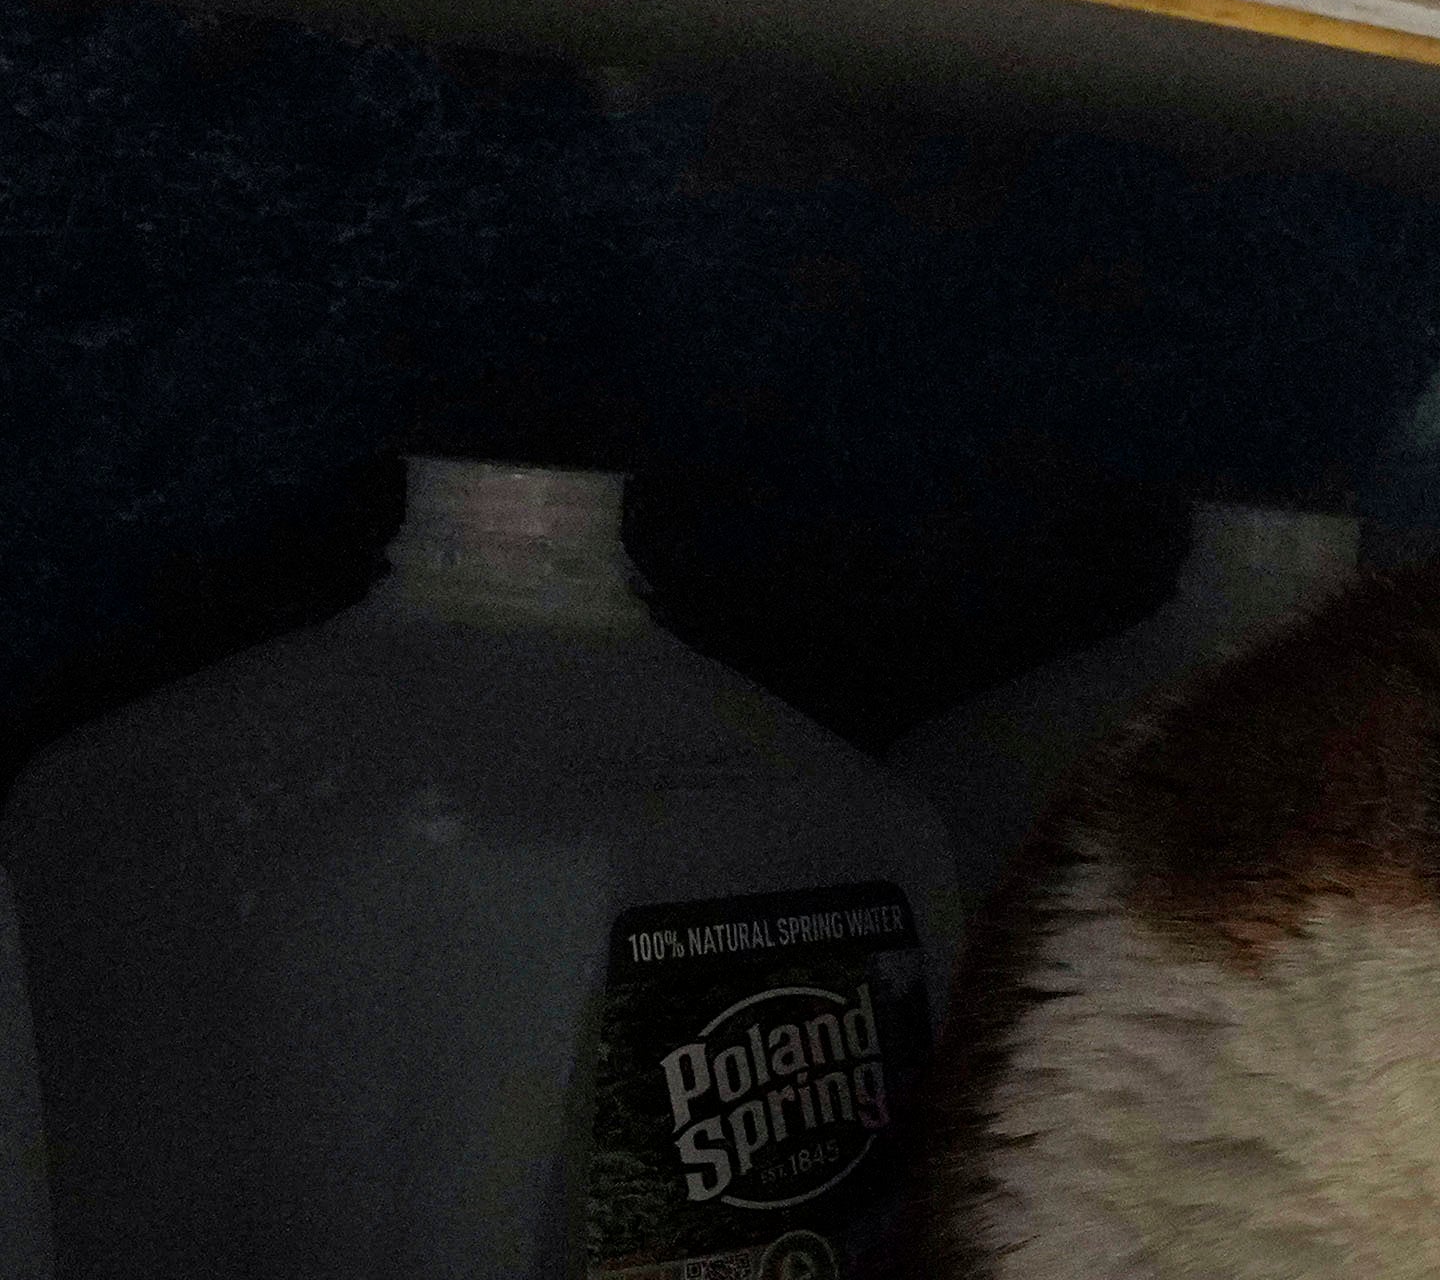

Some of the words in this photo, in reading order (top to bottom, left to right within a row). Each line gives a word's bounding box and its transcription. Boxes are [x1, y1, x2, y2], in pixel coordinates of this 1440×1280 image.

[627, 929, 686, 963] 100%
[687, 919, 776, 957] NATURAL
[776, 911, 845, 946] SPRING
[845, 904, 905, 937] WATER
[659, 982, 882, 1133] Poland
[673, 1061, 892, 1202] Spring
[788, 1138, 840, 1177] 1845
